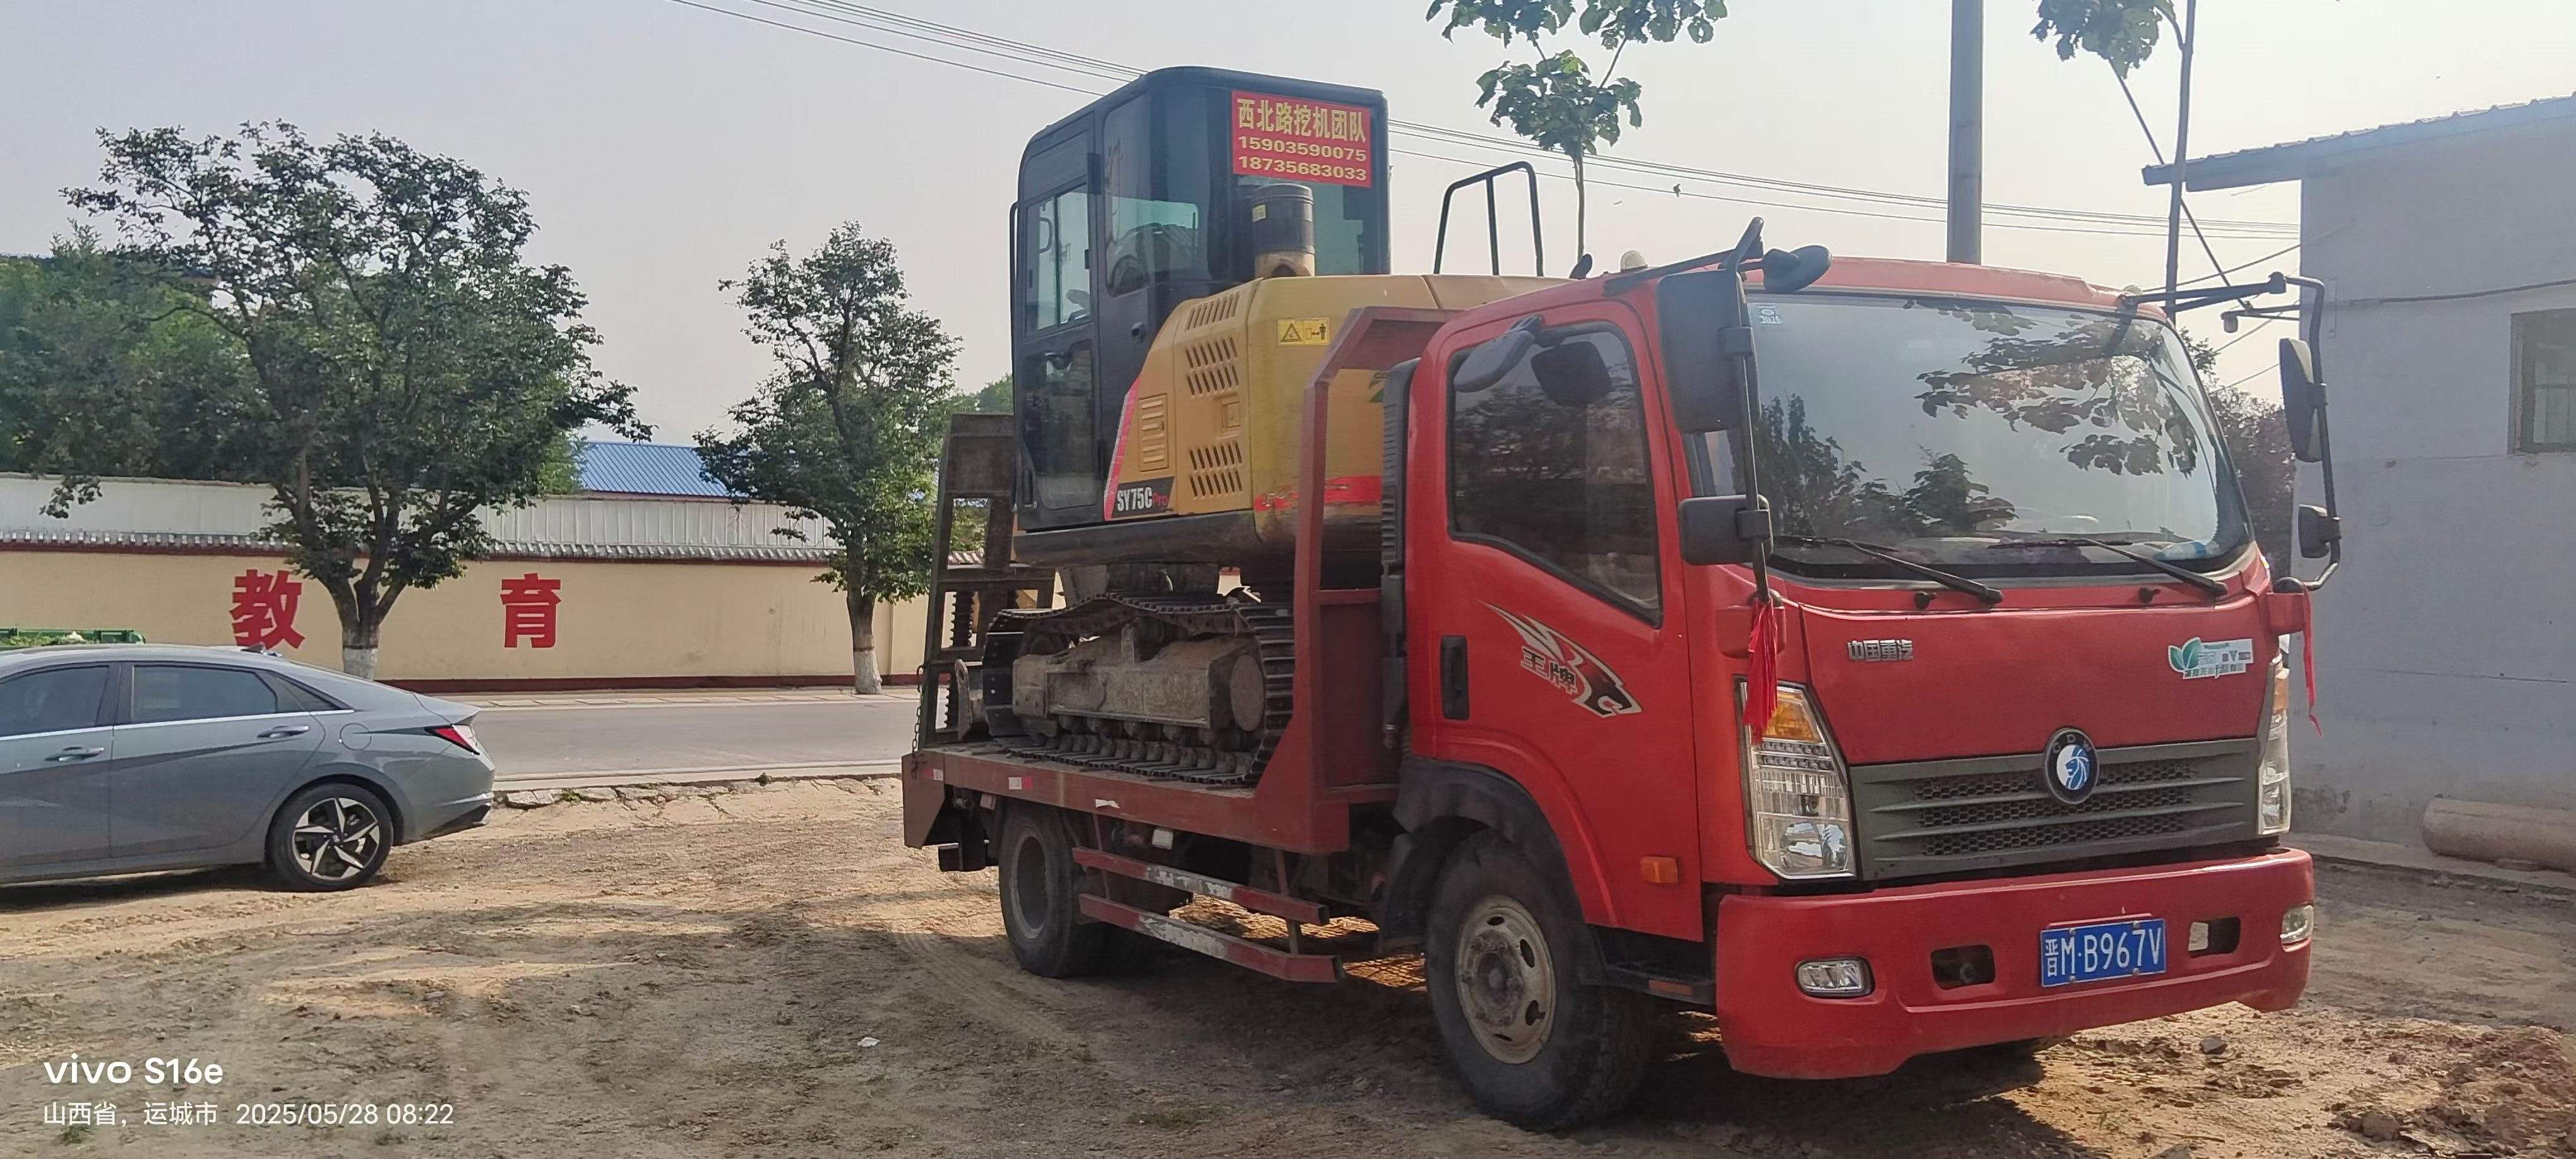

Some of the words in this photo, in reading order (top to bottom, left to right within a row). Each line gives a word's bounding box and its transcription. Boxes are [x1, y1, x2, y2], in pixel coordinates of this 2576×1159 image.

[1237, 98, 1366, 143] 西北路挖机团队
[1238, 136, 1366, 162] 15903590075
[1238, 156, 1367, 181] 18735683033
[1117, 487, 1152, 511] SY75C
[229, 569, 306, 650] 教
[499, 573, 561, 648] 育
[1847, 639, 1913, 662] 中国重汽
